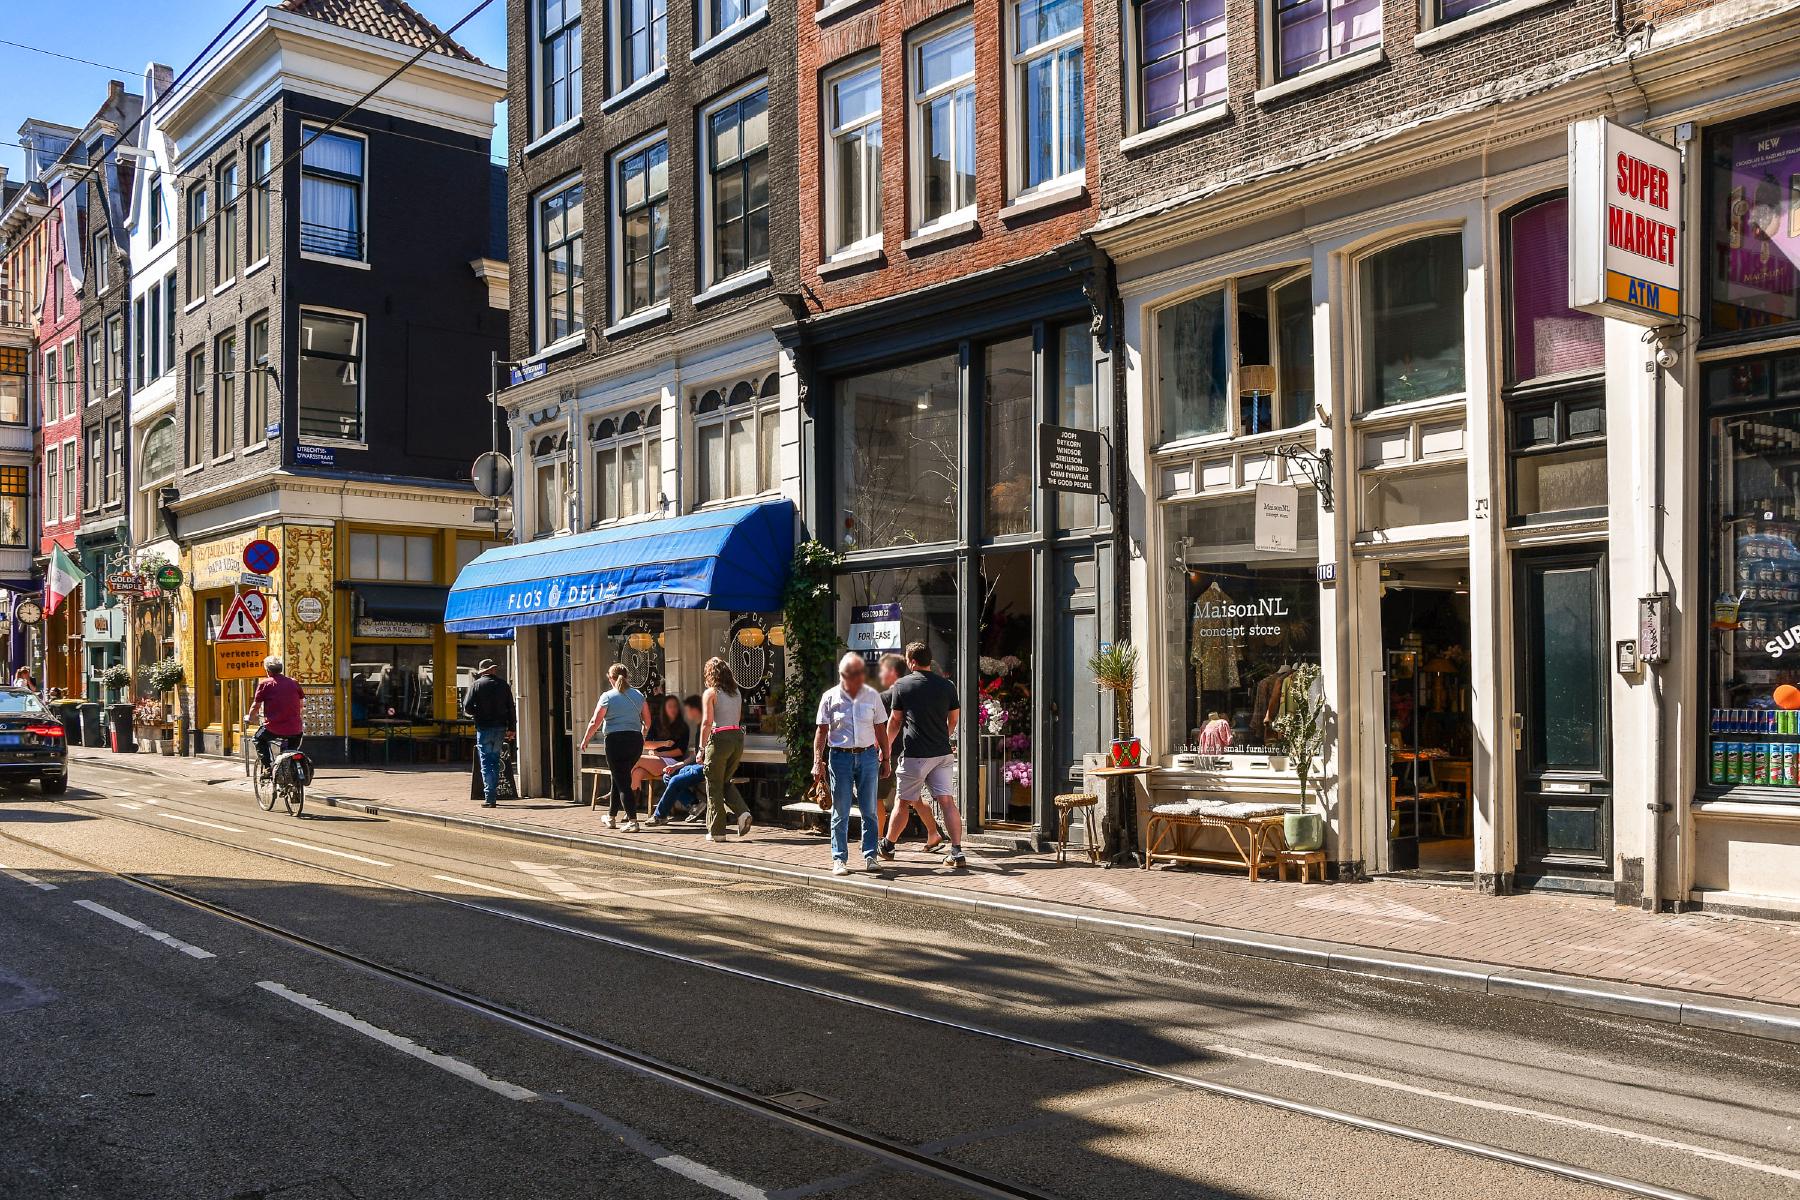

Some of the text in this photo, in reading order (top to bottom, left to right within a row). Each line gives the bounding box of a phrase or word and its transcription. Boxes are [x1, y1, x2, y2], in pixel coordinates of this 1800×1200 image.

[1758, 137, 1779, 152] NEW
[1617, 151, 1669, 211] SUPER
[1608, 203, 1677, 266] MARKET
[1628, 279, 1659, 310] ATM
[1061, 431, 1077, 440] JOOP!
[1056, 446, 1081, 456] WINDSOR
[1050, 462, 1089, 473] WON HUNDRED
[1065, 472, 1089, 481] EYEWEAR
[1047, 477, 1093, 489] THE GOOD PEOPLE
[1263, 502, 1290, 512] MaisonNL
[1319, 566, 1333, 580] 118
[110, 575, 142, 583] GOLDEN
[111, 582, 143, 590] TEMPLE
[507, 590, 542, 610] FLO'S
[568, 583, 604, 603] DELI
[1193, 597, 1289, 619] MaisonNL
[858, 631, 891, 641] FOR LEASE
[1200, 624, 1281, 640] concept store
[220, 649, 264, 658] verkeers-
[1174, 743, 1188, 754] high
[1224, 744, 1245, 753] small
[1246, 744, 1280, 753] furniture
